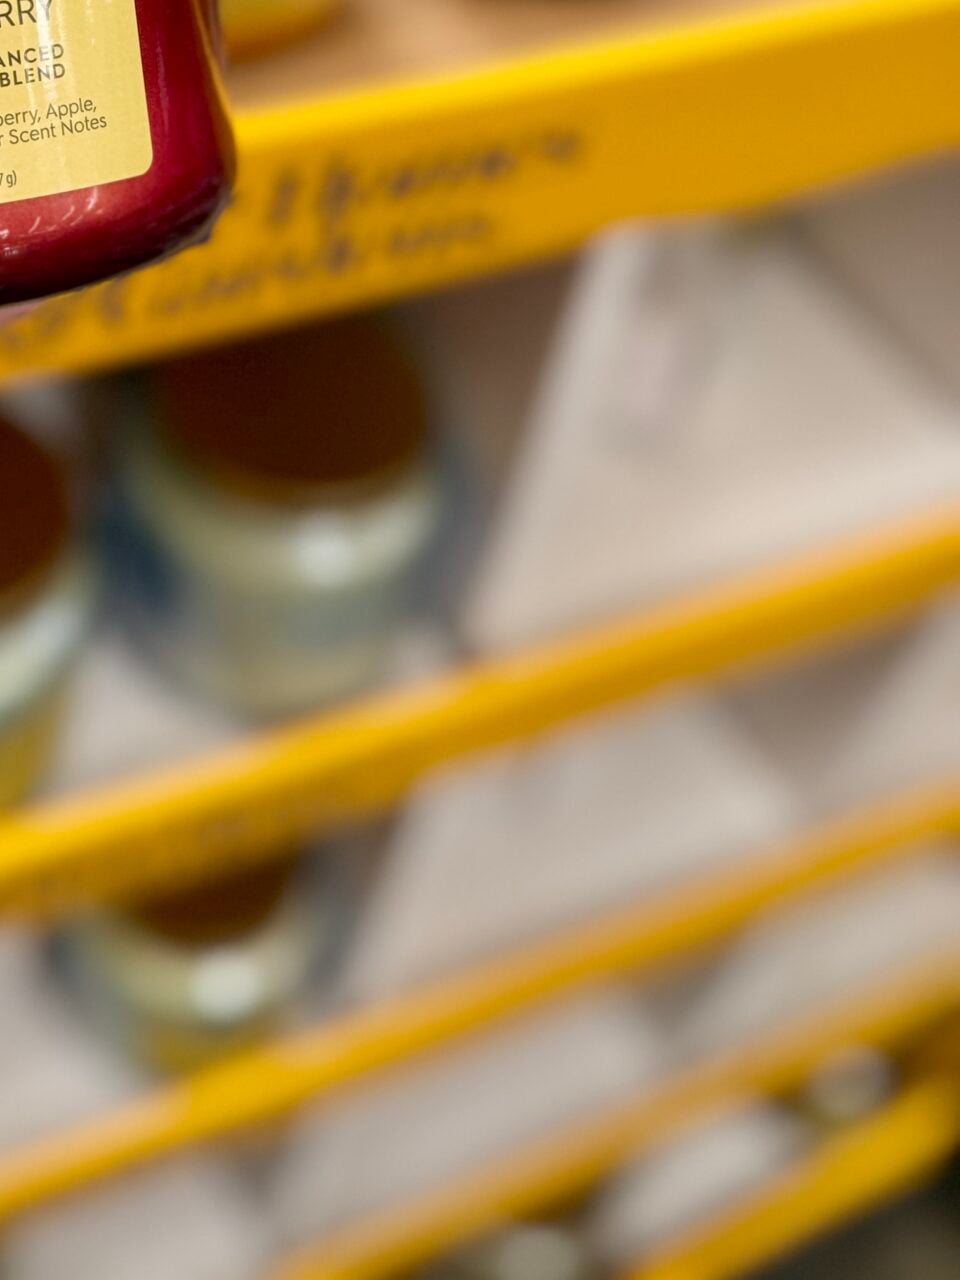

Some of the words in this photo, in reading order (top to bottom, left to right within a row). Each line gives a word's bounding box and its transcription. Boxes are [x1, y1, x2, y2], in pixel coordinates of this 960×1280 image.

[0, 63, 66, 87] BLEND
[45, 98, 97, 123] Apple,
[9, 124, 57, 145] Scent
[60, 115, 107, 138] Notes
[6, 170, 17, 187] g)
